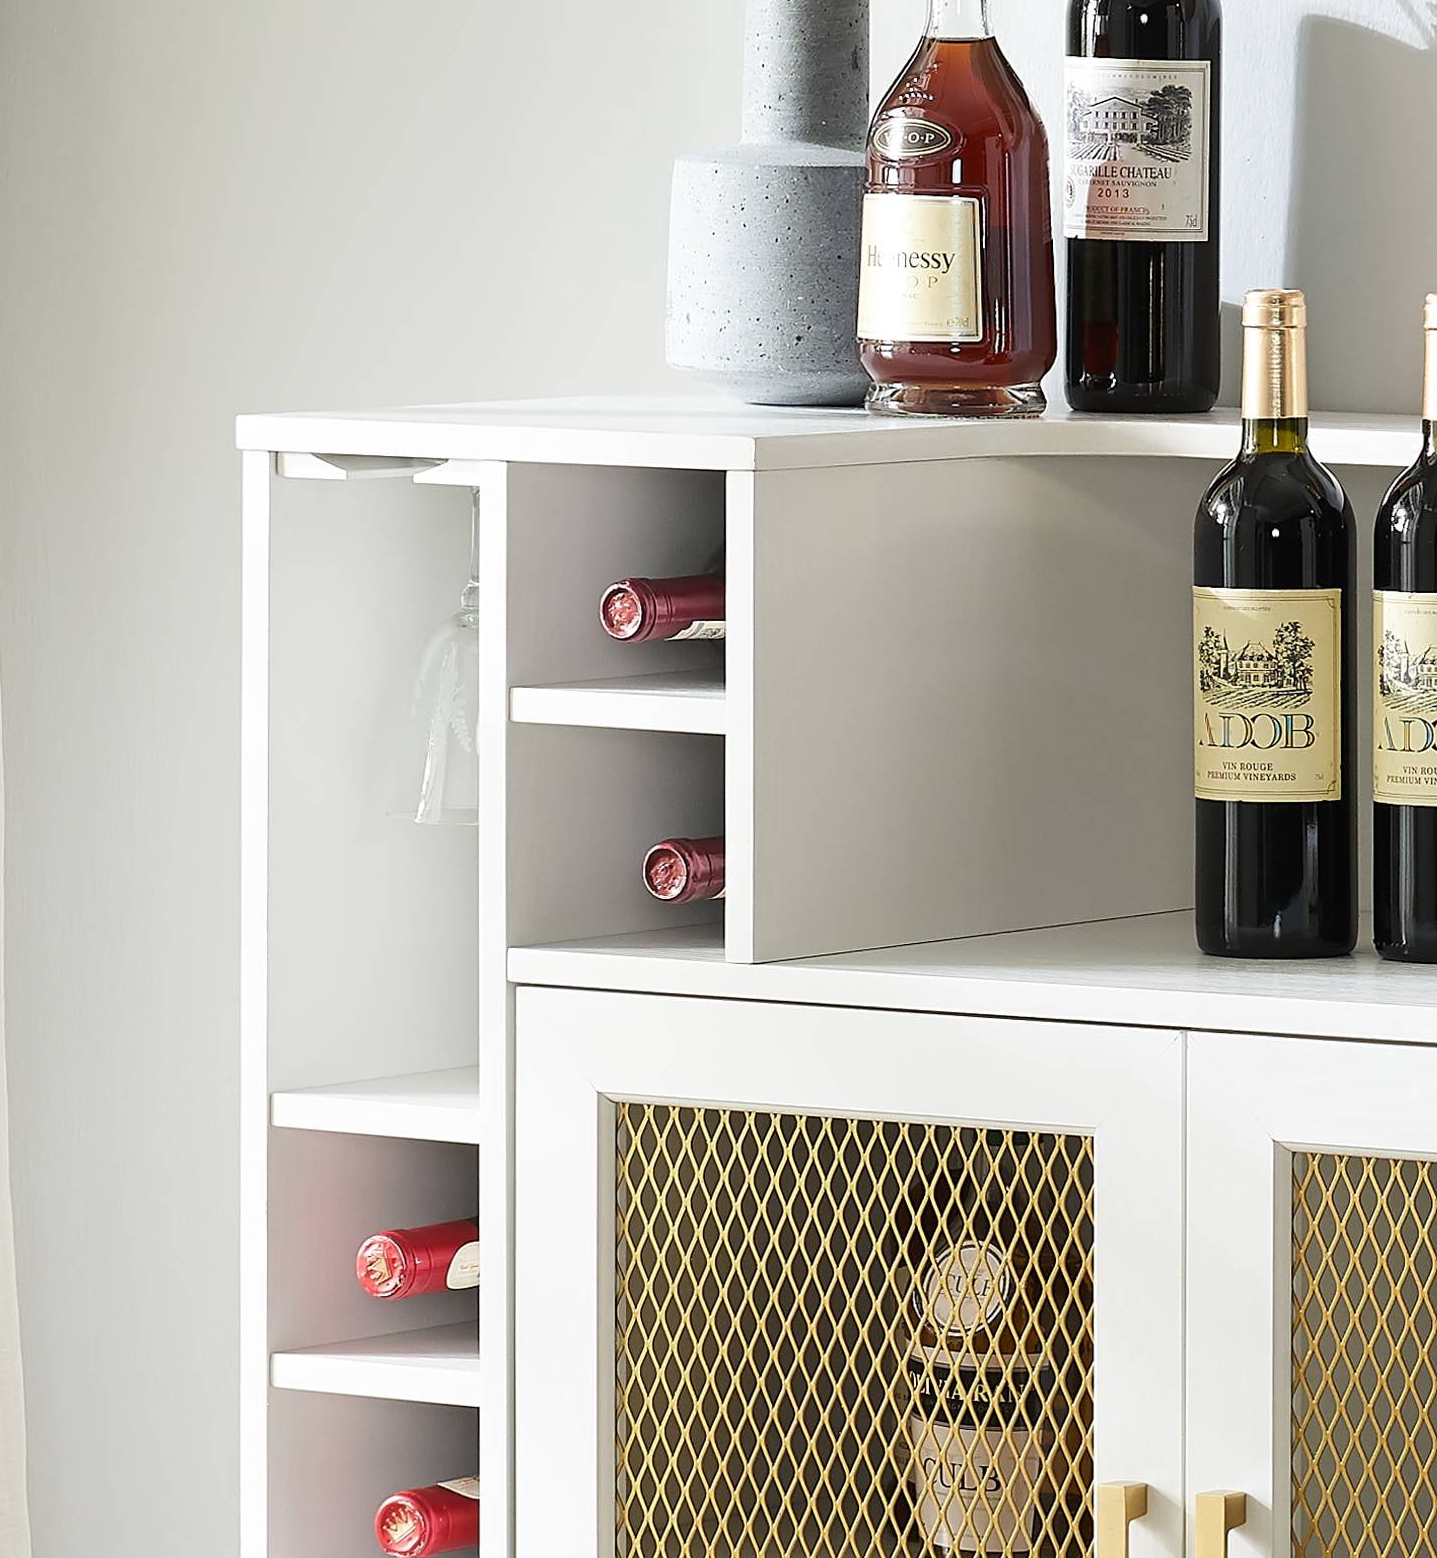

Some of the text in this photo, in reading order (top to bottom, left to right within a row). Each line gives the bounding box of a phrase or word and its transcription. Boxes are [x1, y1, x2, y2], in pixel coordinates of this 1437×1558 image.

[1119, 166, 1172, 179] CHATEAU
[1111, 180, 1157, 188] SAUVIGNON
[1097, 188, 1130, 199] 2013
[867, 244, 956, 274] Henessy
[1222, 761, 1274, 771] VIN ROUGE
[1403, 765, 1417, 775] VIN
[1207, 770, 1297, 781] PREMIUM VINEYARDS
[1386, 774, 1421, 785] PREMIUM
